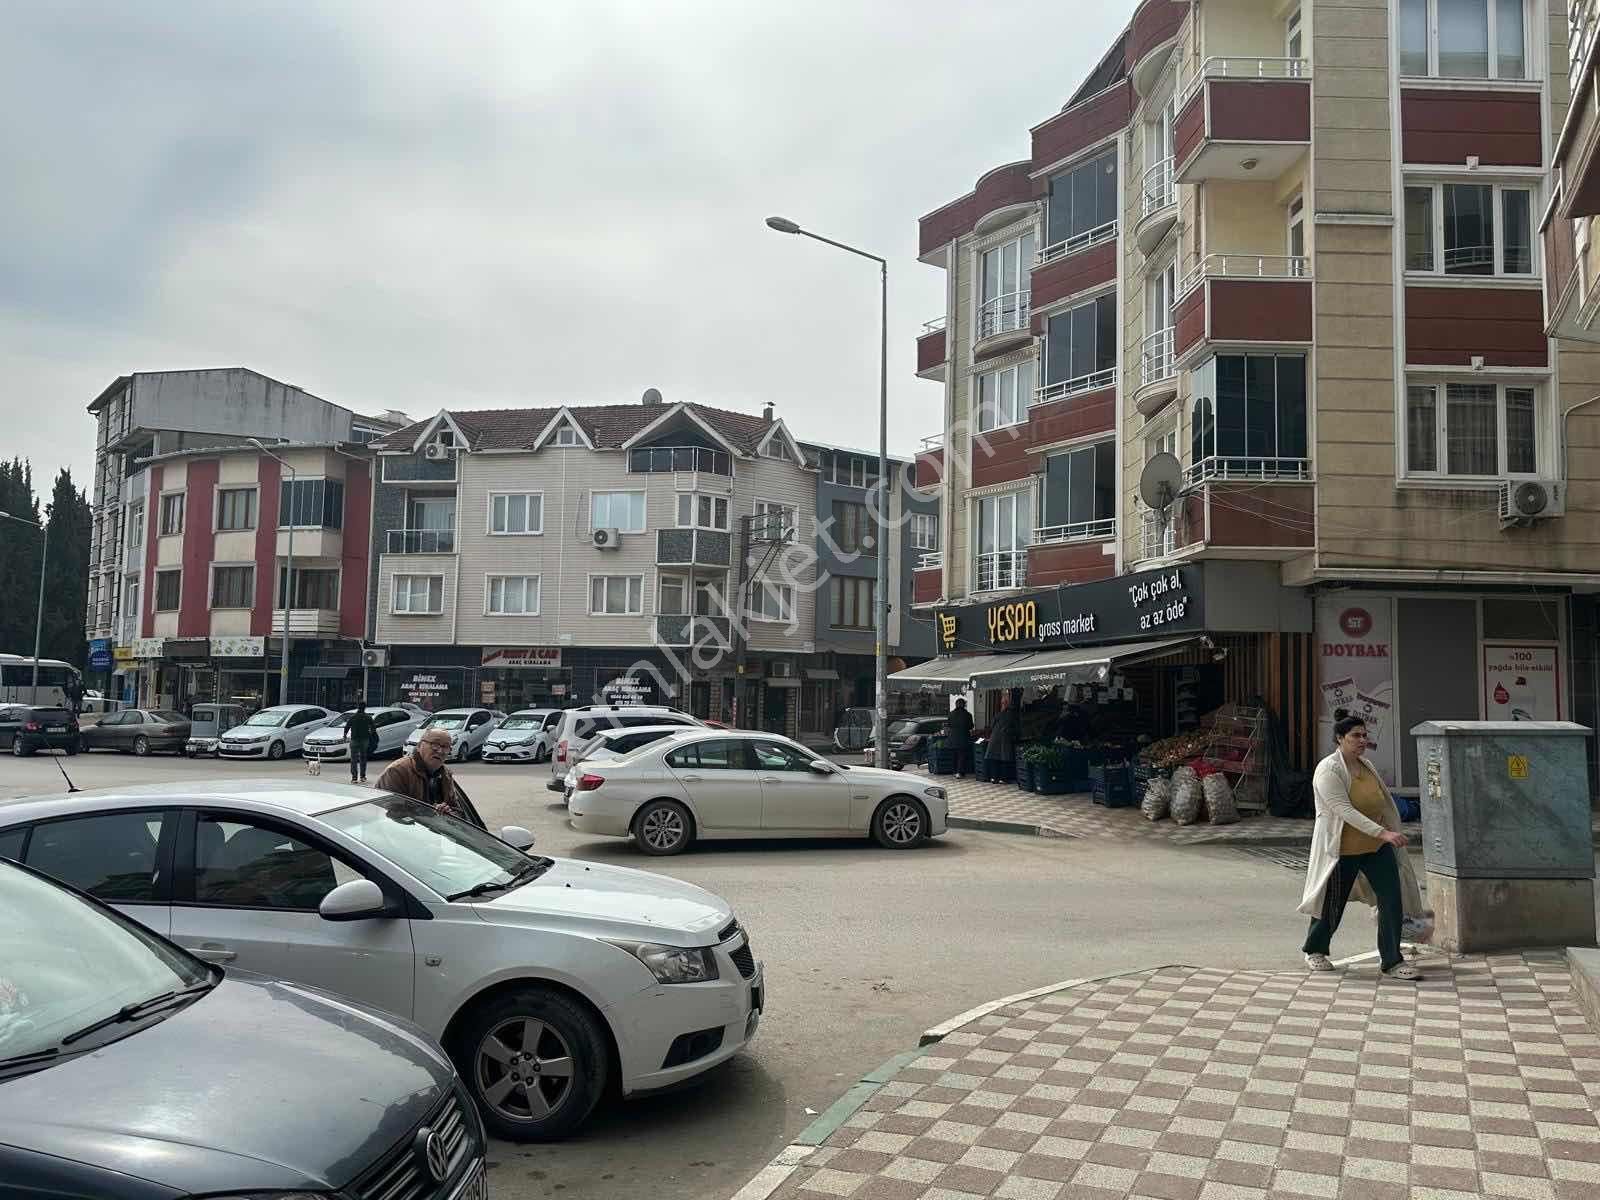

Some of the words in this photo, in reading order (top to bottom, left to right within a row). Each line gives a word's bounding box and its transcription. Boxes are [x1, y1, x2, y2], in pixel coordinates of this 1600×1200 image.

[1128, 585, 1149, 608] "Çok
[1150, 577, 1168, 598] çok
[1170, 569, 1182, 591] al,
[987, 600, 1037, 644] YESPA
[1038, 621, 1061, 642] gross
[1062, 613, 1095, 633] market
[1140, 614, 1151, 630] az
[1153, 611, 1165, 626] az
[1166, 596, 1188, 624] öde"
[1321, 643, 1389, 657] DOYBAK
